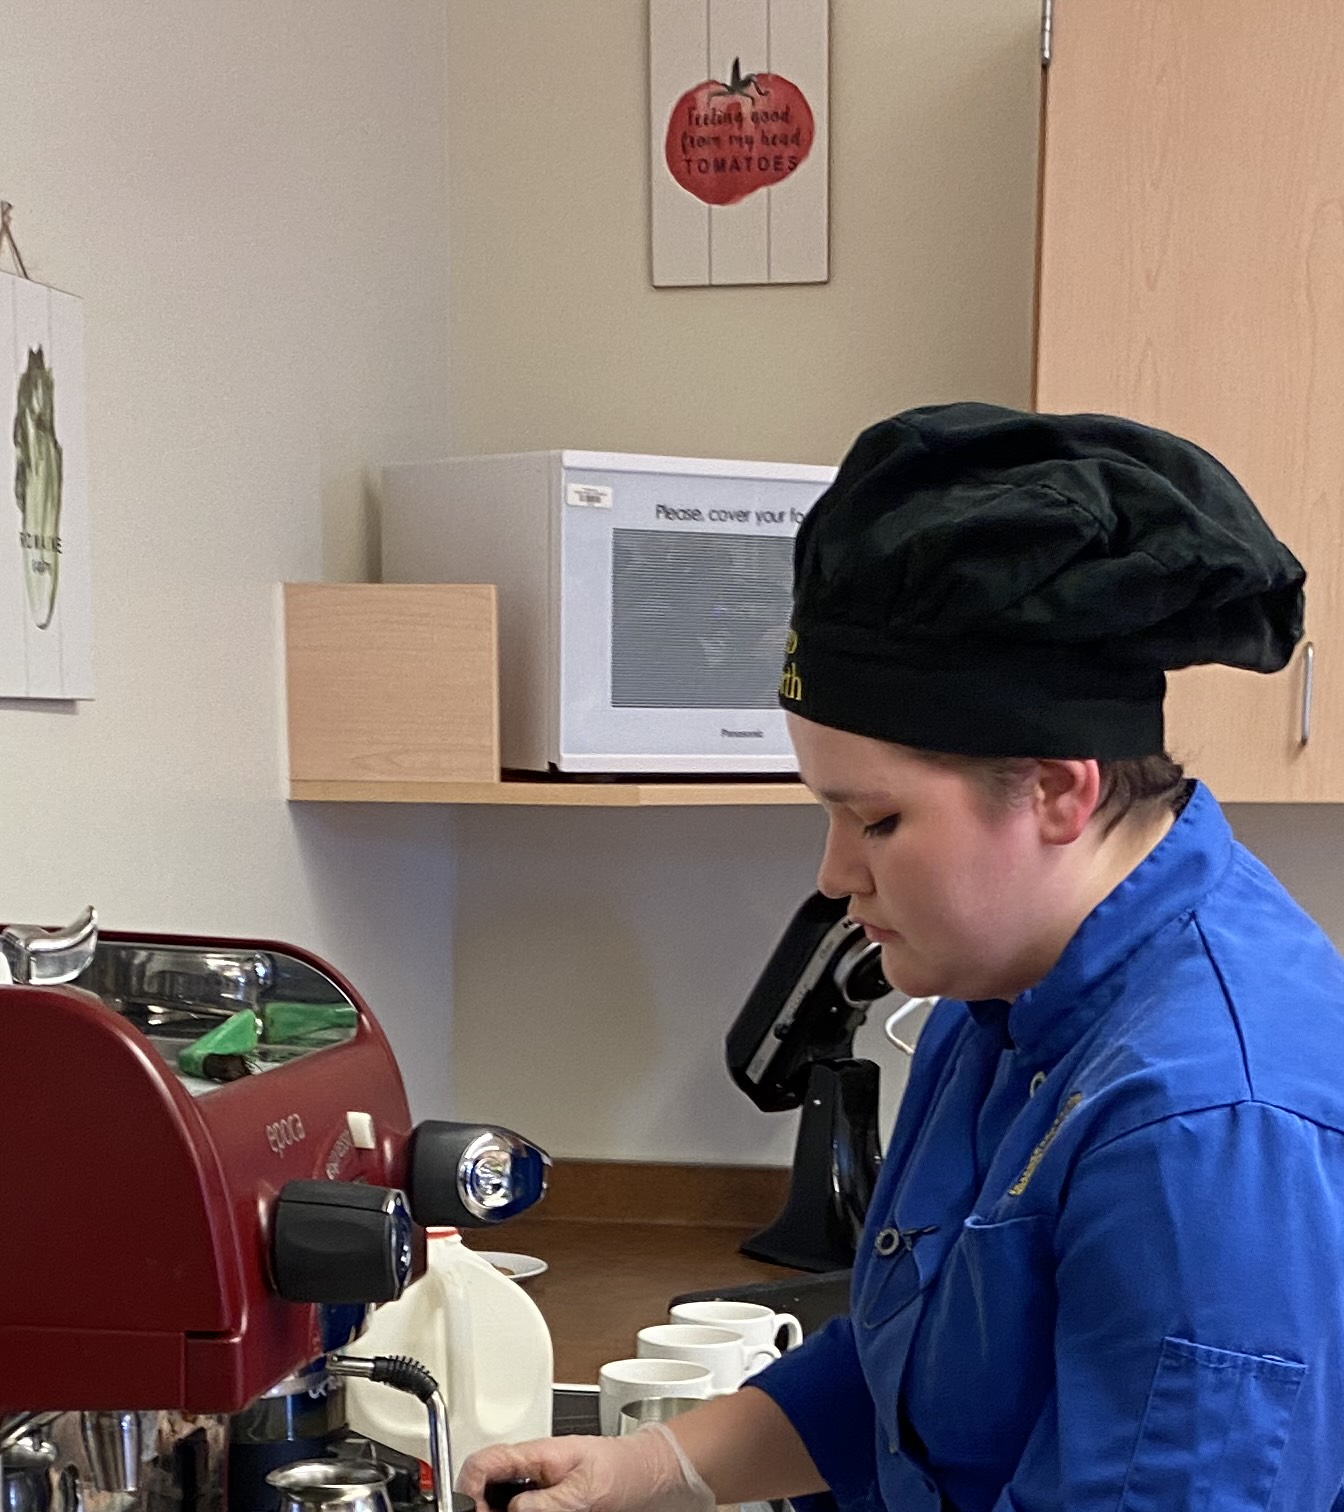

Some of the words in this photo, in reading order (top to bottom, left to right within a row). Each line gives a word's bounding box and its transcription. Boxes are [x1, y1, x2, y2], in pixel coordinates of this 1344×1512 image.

[750, 104, 791, 128] good
[681, 131, 721, 154] from
[728, 134, 754, 153] my
[760, 128, 802, 147] head
[683, 155, 800, 176] TOMATOES
[707, 508, 752, 523] cover
[754, 509, 786, 526] your
